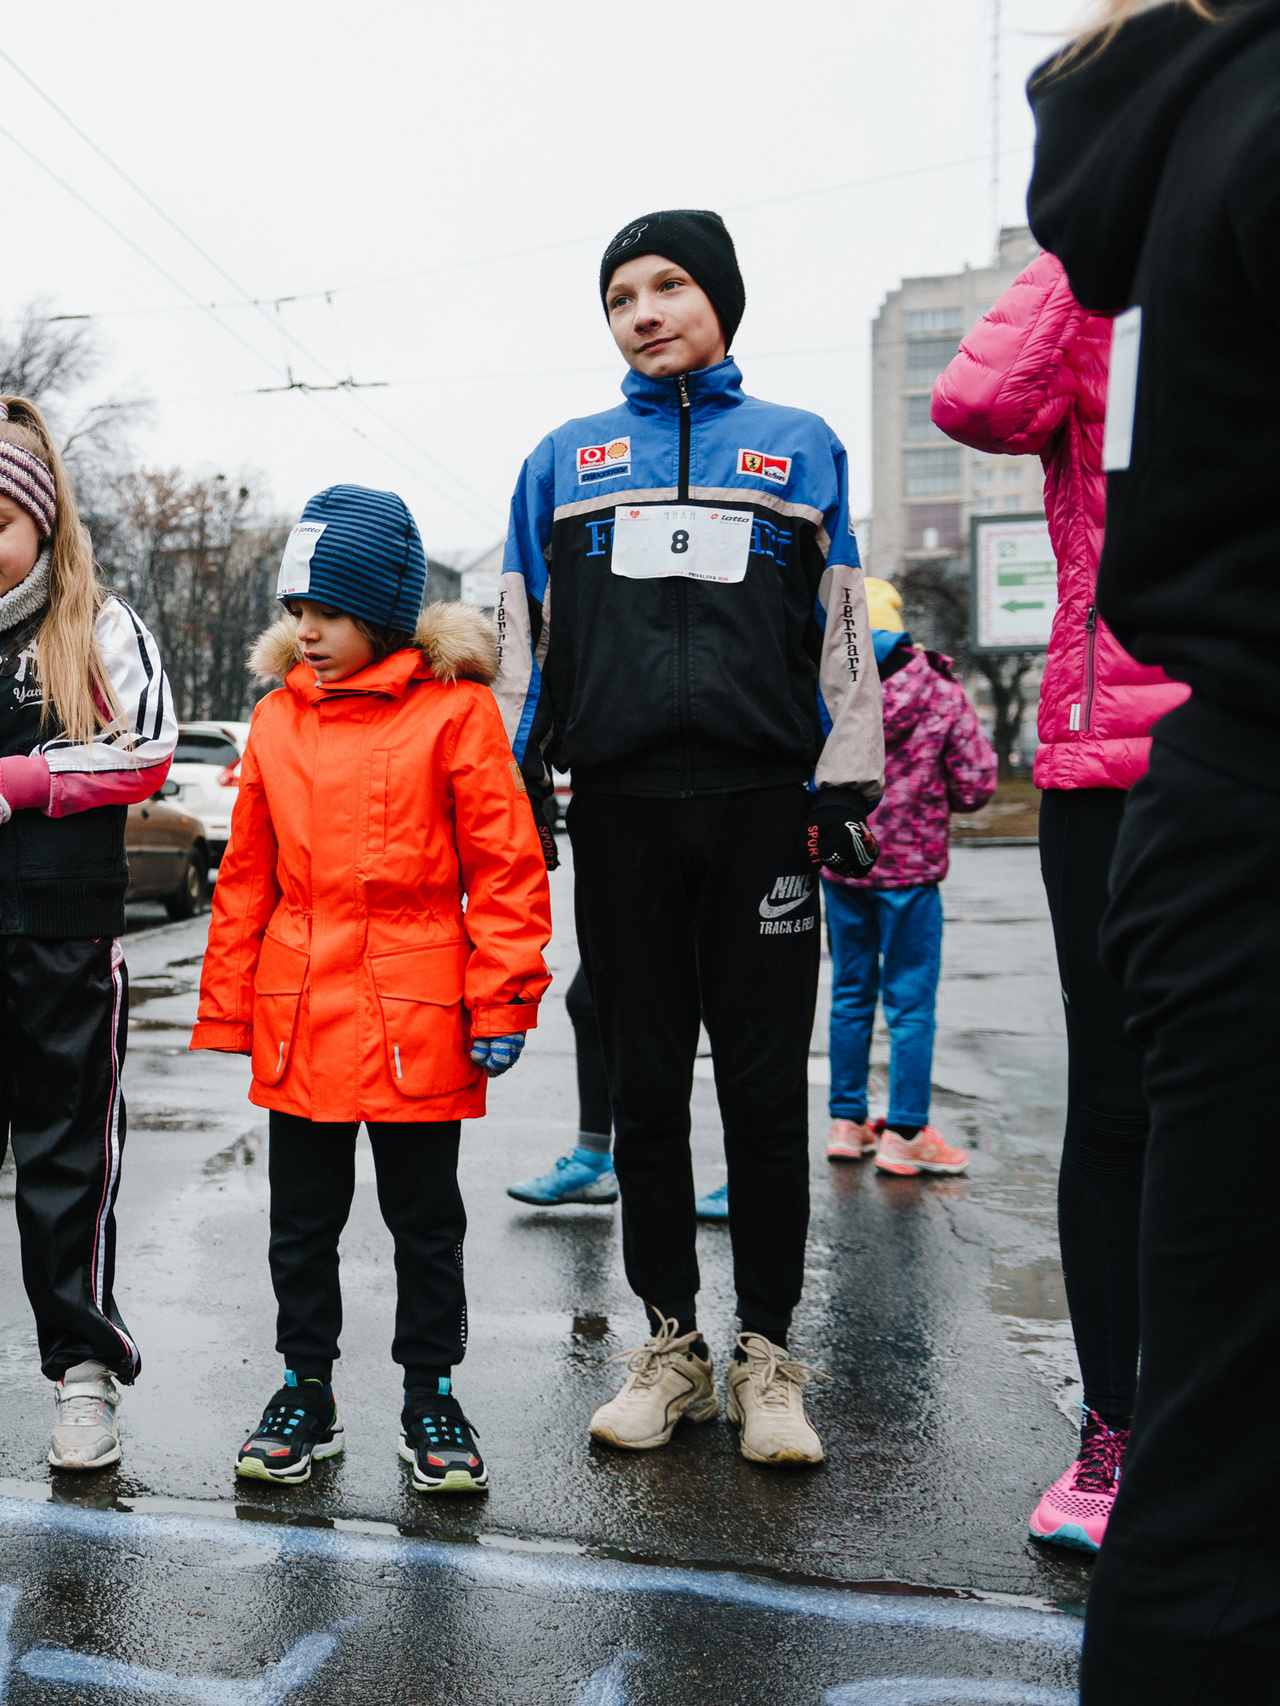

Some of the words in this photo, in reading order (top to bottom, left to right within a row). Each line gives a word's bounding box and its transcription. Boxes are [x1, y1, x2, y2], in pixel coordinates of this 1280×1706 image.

[671, 529, 690, 554] 8
[688, 572, 716, 580] PRIVALOVA
[842, 588, 860, 682] Ferrari
[760, 920, 793, 934] TRACK
[793, 919, 802, 933] &
